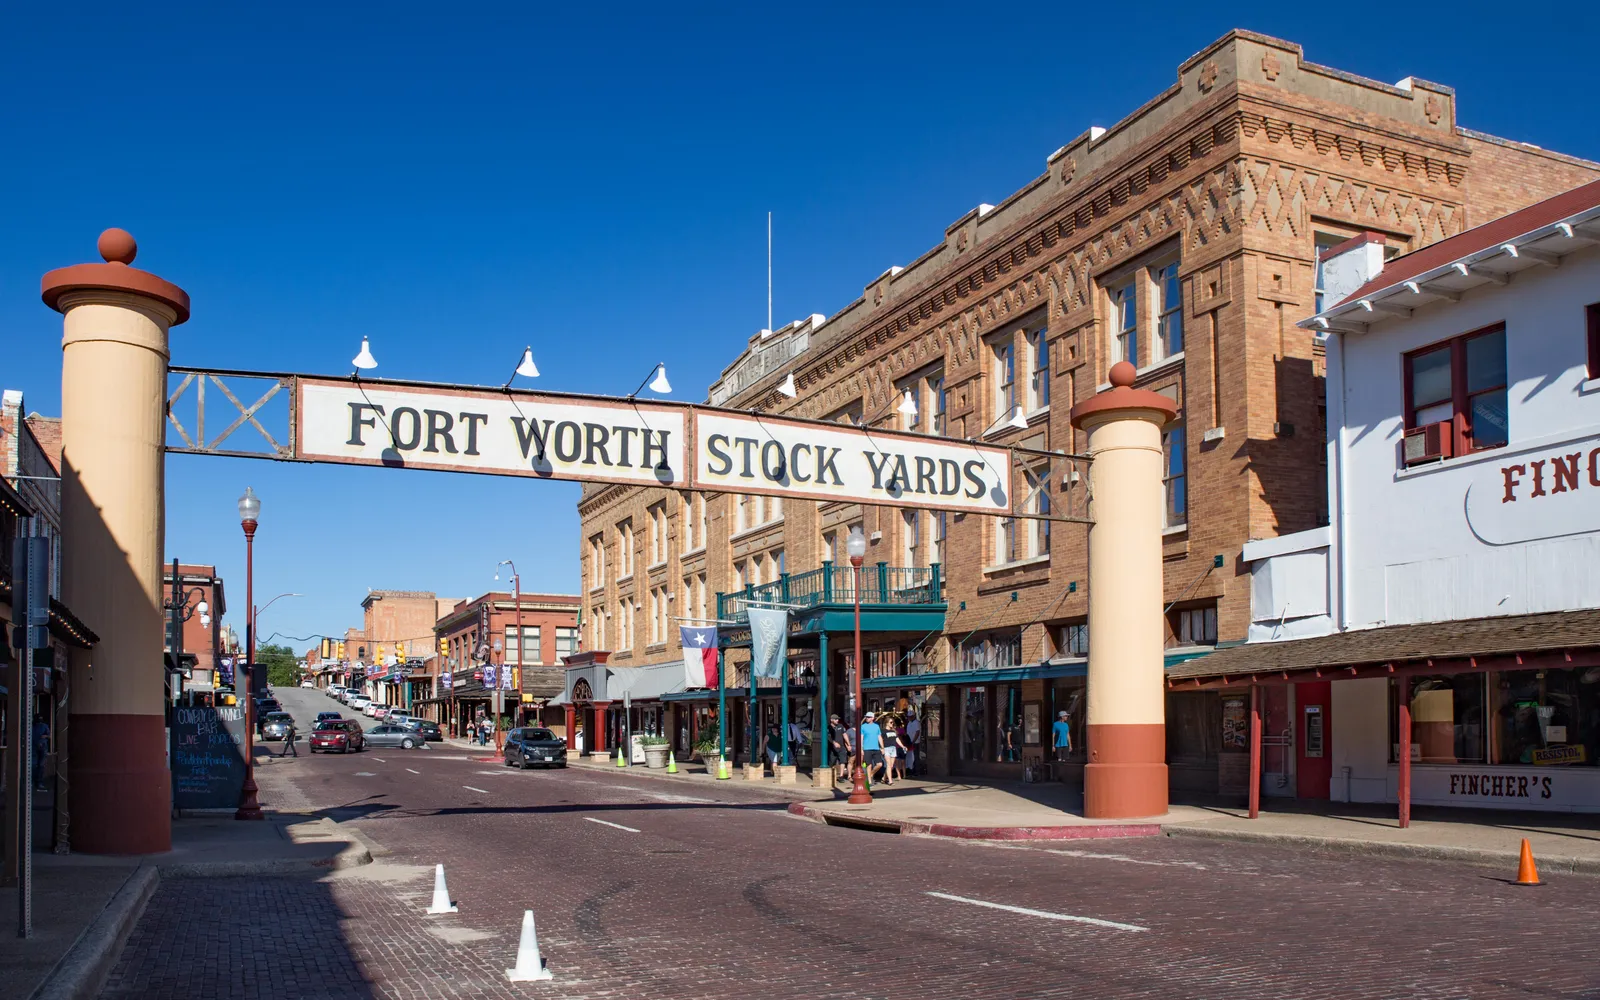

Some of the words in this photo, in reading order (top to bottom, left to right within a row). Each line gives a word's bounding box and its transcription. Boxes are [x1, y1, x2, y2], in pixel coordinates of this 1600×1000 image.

[345, 401, 488, 456] FORT
[510, 416, 671, 471] WORTH
[707, 433, 845, 486] STOCK
[862, 450, 986, 500] YARDS
[178, 708, 207, 724] COWBOY
[1535, 747, 1581, 761] RESISTOL
[1449, 774, 1552, 799] FINCHER'S
